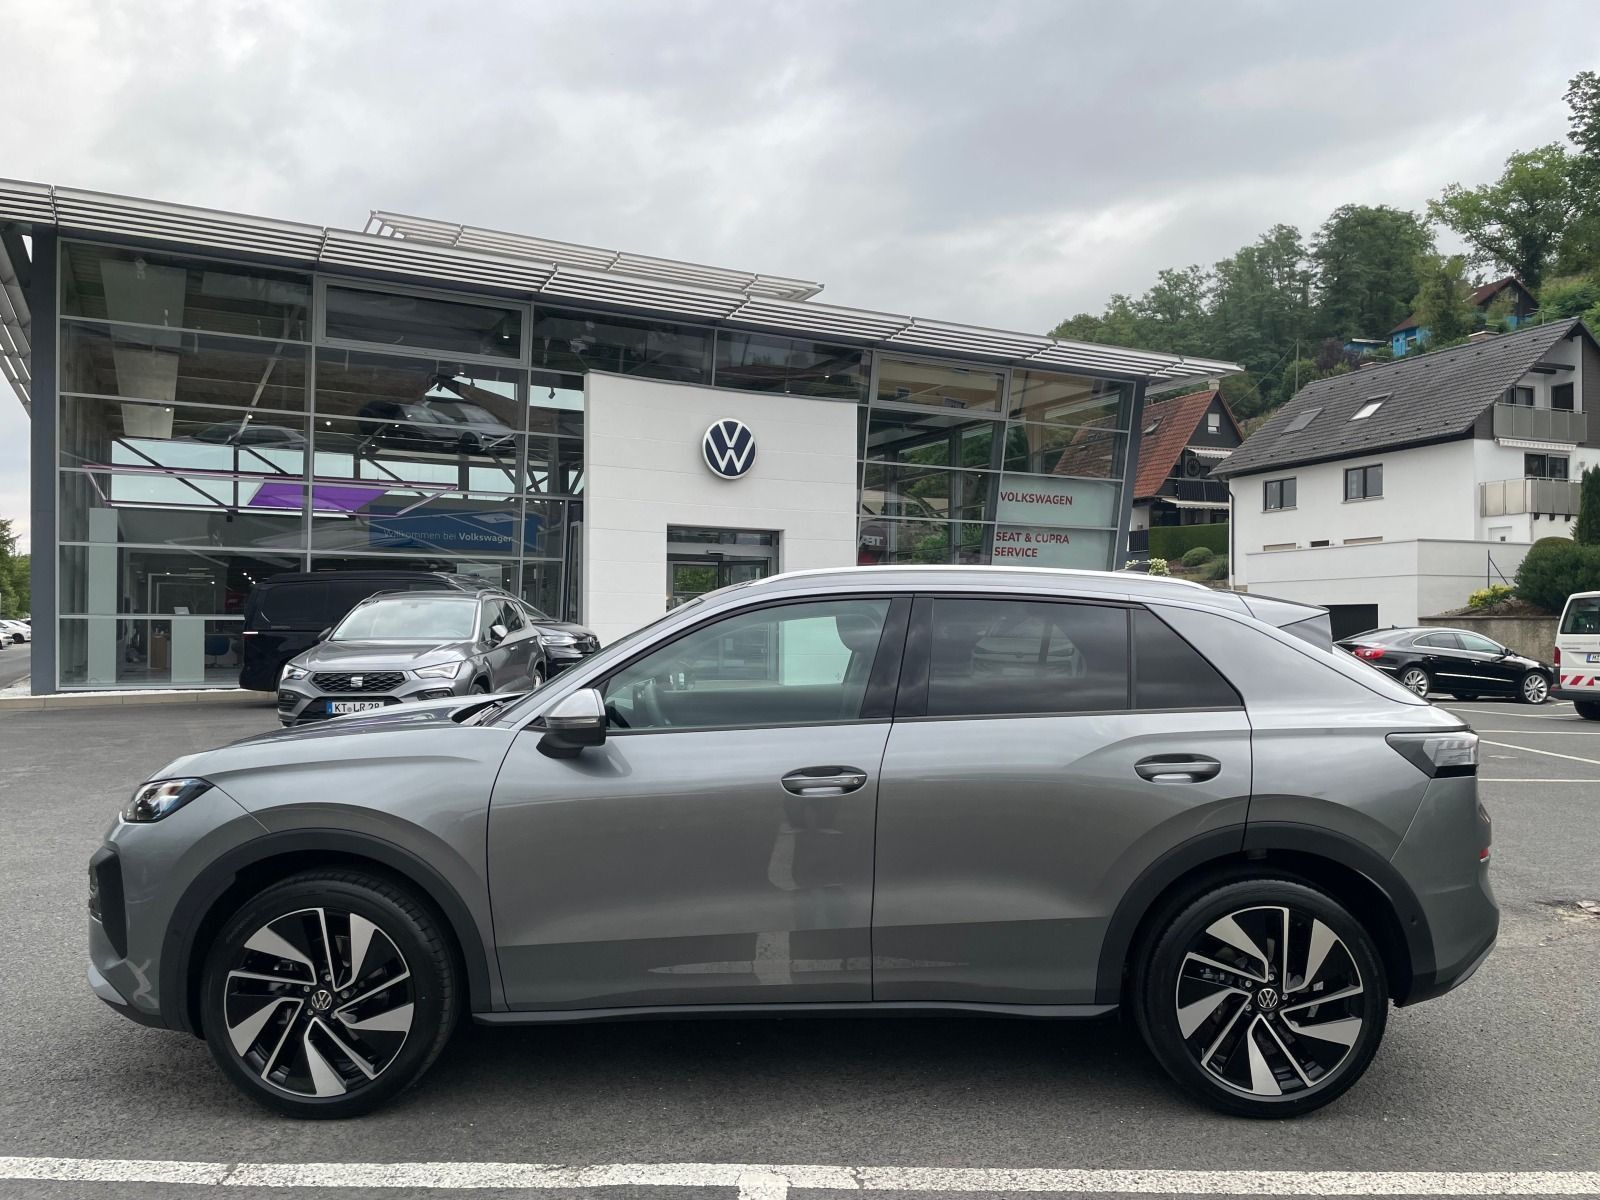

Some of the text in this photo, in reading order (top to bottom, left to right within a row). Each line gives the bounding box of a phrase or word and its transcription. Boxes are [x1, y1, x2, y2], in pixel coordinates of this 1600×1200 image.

[1000, 491, 1073, 505] VOLKSWAGEN
[996, 531, 1070, 544] SEAT & CUPRA
[994, 546, 1038, 558] SERVICE
[334, 703, 347, 713] KT
